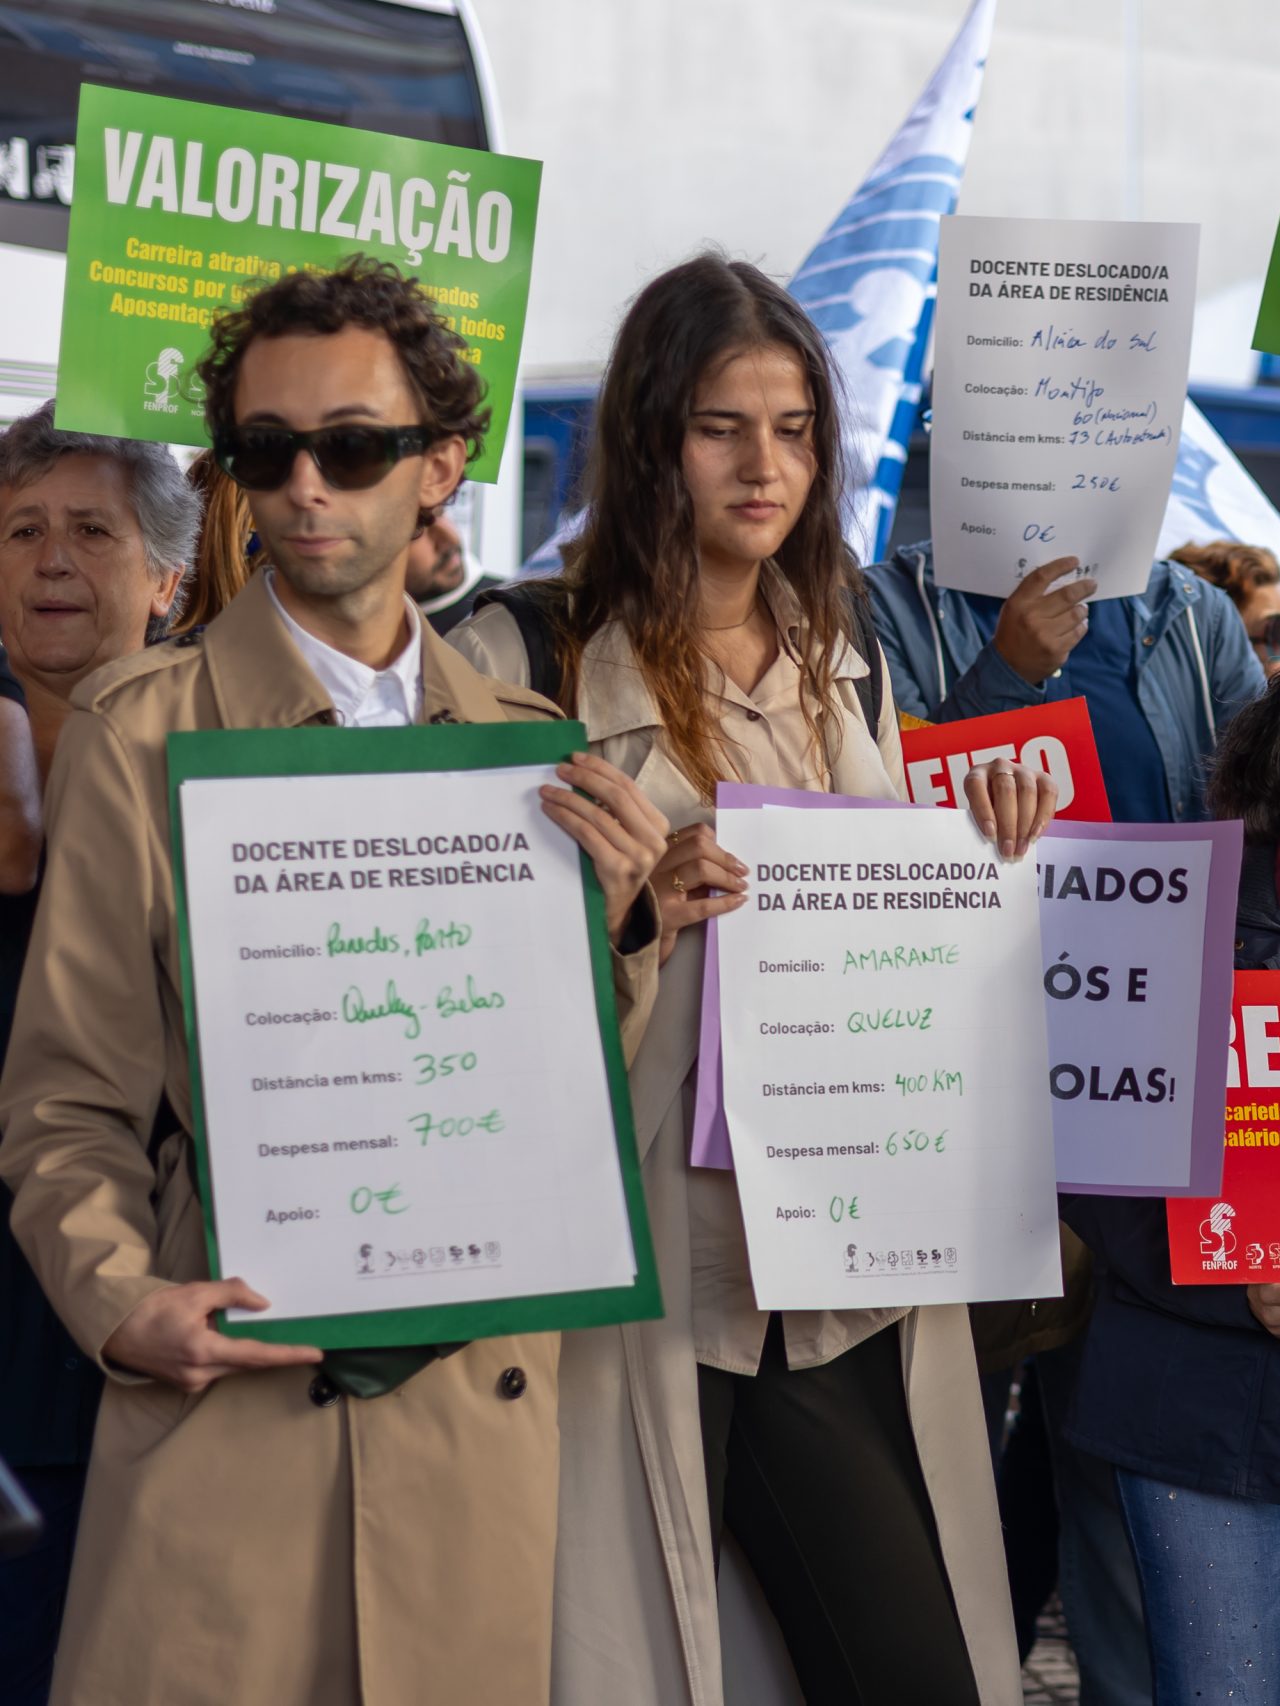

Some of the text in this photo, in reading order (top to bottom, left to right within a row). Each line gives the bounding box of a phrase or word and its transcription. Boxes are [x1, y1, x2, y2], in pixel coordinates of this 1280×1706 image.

[104, 127, 513, 267] VALORIZAÇÃO
[126, 237, 204, 268] Carreira
[208, 251, 282, 279] atrativa
[89, 260, 189, 294] Concursos
[193, 279, 226, 299] por
[970, 259, 1169, 281] DOCENTE DESLOCADO/A
[969, 281, 1169, 303] DA ÁREA DE RESIDÊNCIA
[460, 315, 506, 342] todos
[966, 335, 1024, 348] Domicílio:
[965, 383, 1028, 397] Colocação:
[143, 400, 179, 414] FENPROF
[963, 430, 1065, 445] Distância em kms:
[961, 477, 1056, 494] Despesa mensal:
[961, 522, 996, 537] Apoio:
[1023, 524, 1056, 543] 0€
[232, 832, 531, 863] DOCENTE DESLOCADO/A
[234, 860, 536, 894] DA ÁREA DE RESIDÊNCIA
[757, 862, 999, 882] DOCENTE DESLOCADO/A
[1036, 867, 1190, 904] IADOS
[758, 887, 1001, 911] DA ÁREA DE RESIDÊNCIA
[239, 945, 322, 961] Domicílio:
[843, 945, 960, 975] AMARANTE
[759, 959, 825, 974] Domicílio:
[1126, 967, 1149, 1003] E
[245, 1010, 338, 1027] Colocação:
[760, 1022, 835, 1037] Colocação:
[847, 1007, 933, 1034] QUELUZ
[412, 1051, 478, 1085] 350
[251, 1068, 403, 1092] Distância em kms:
[762, 1080, 885, 1097] Distância em kms:
[895, 1069, 963, 1096] 400 KM
[407, 1109, 506, 1147] 700€
[258, 1134, 399, 1158] Despesa mensal:
[766, 1140, 880, 1159] Despesa mensal:
[349, 1182, 411, 1216] 0€
[265, 1207, 321, 1224] Apoio:
[776, 1206, 816, 1220] Apoio:
[1202, 1260, 1238, 1271] FENPROF
